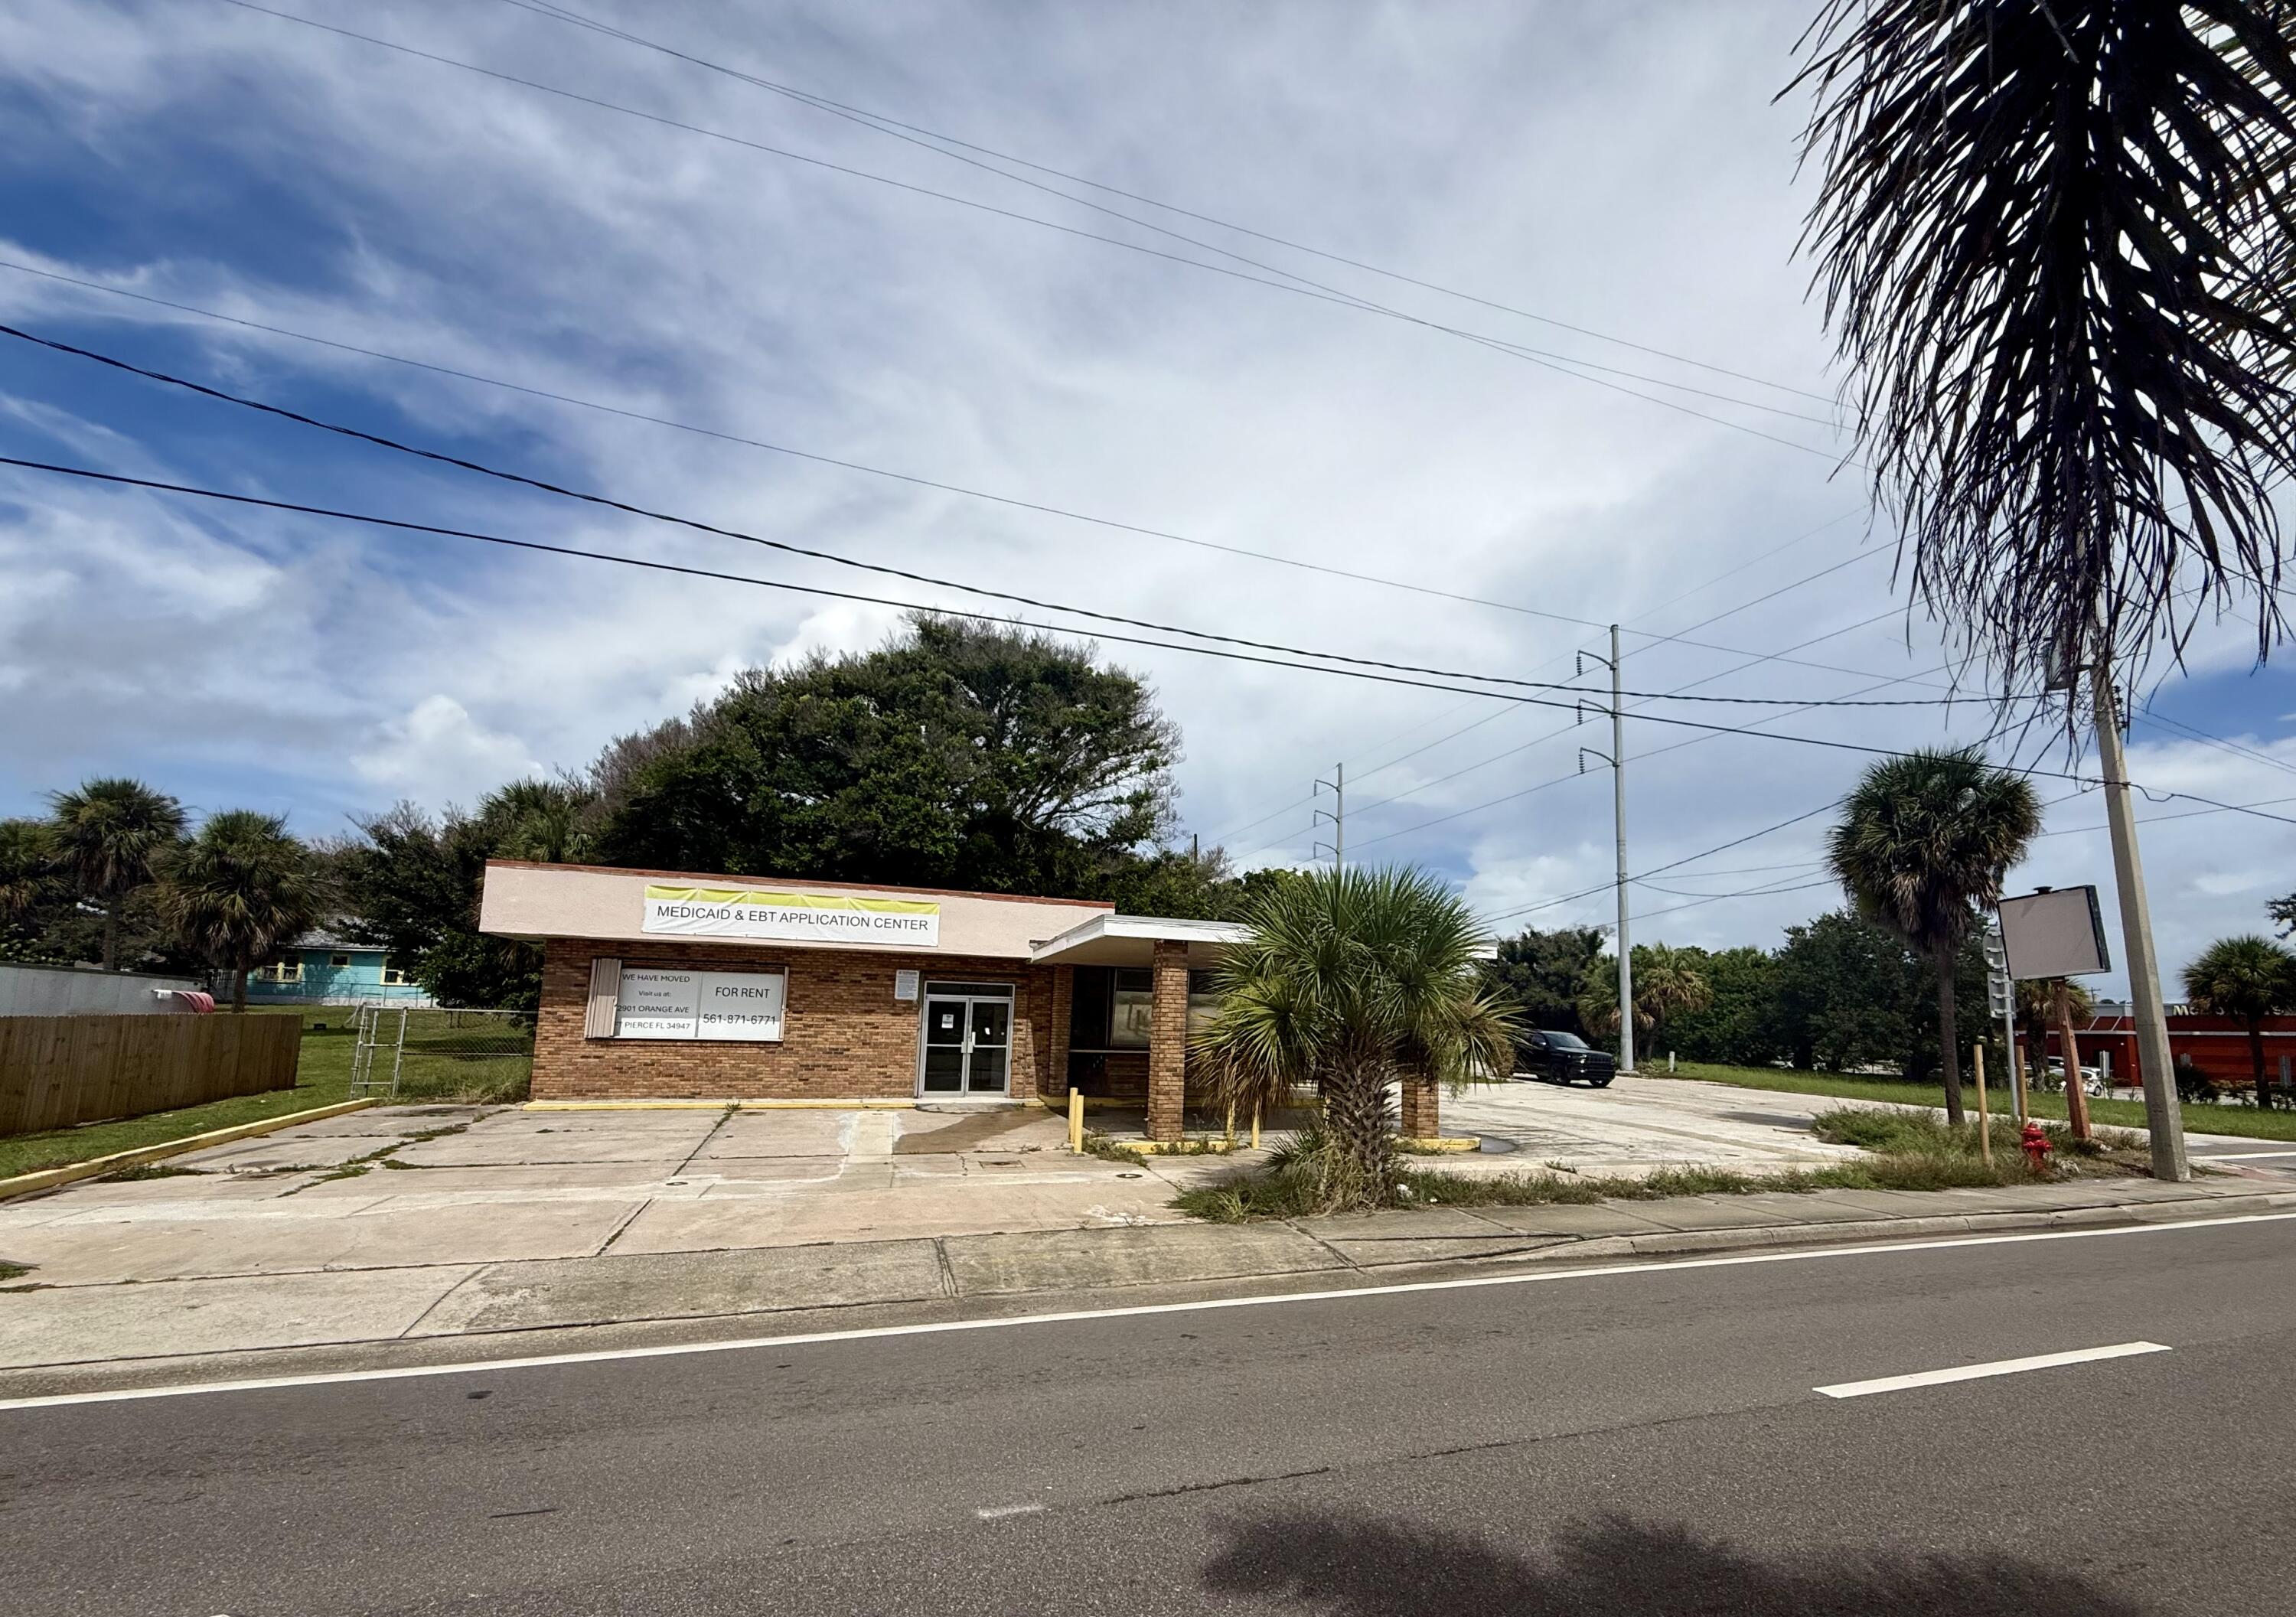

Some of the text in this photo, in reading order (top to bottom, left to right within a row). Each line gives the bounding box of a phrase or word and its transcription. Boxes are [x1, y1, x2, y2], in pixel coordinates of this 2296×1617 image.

[657, 905, 928, 931] MEDICAID & EBT APPLICATION CENTER
[715, 986, 771, 999] FOR RENT
[638, 1005, 673, 1013] ORANGE
[703, 1013, 776, 1025] 561-871-6771
